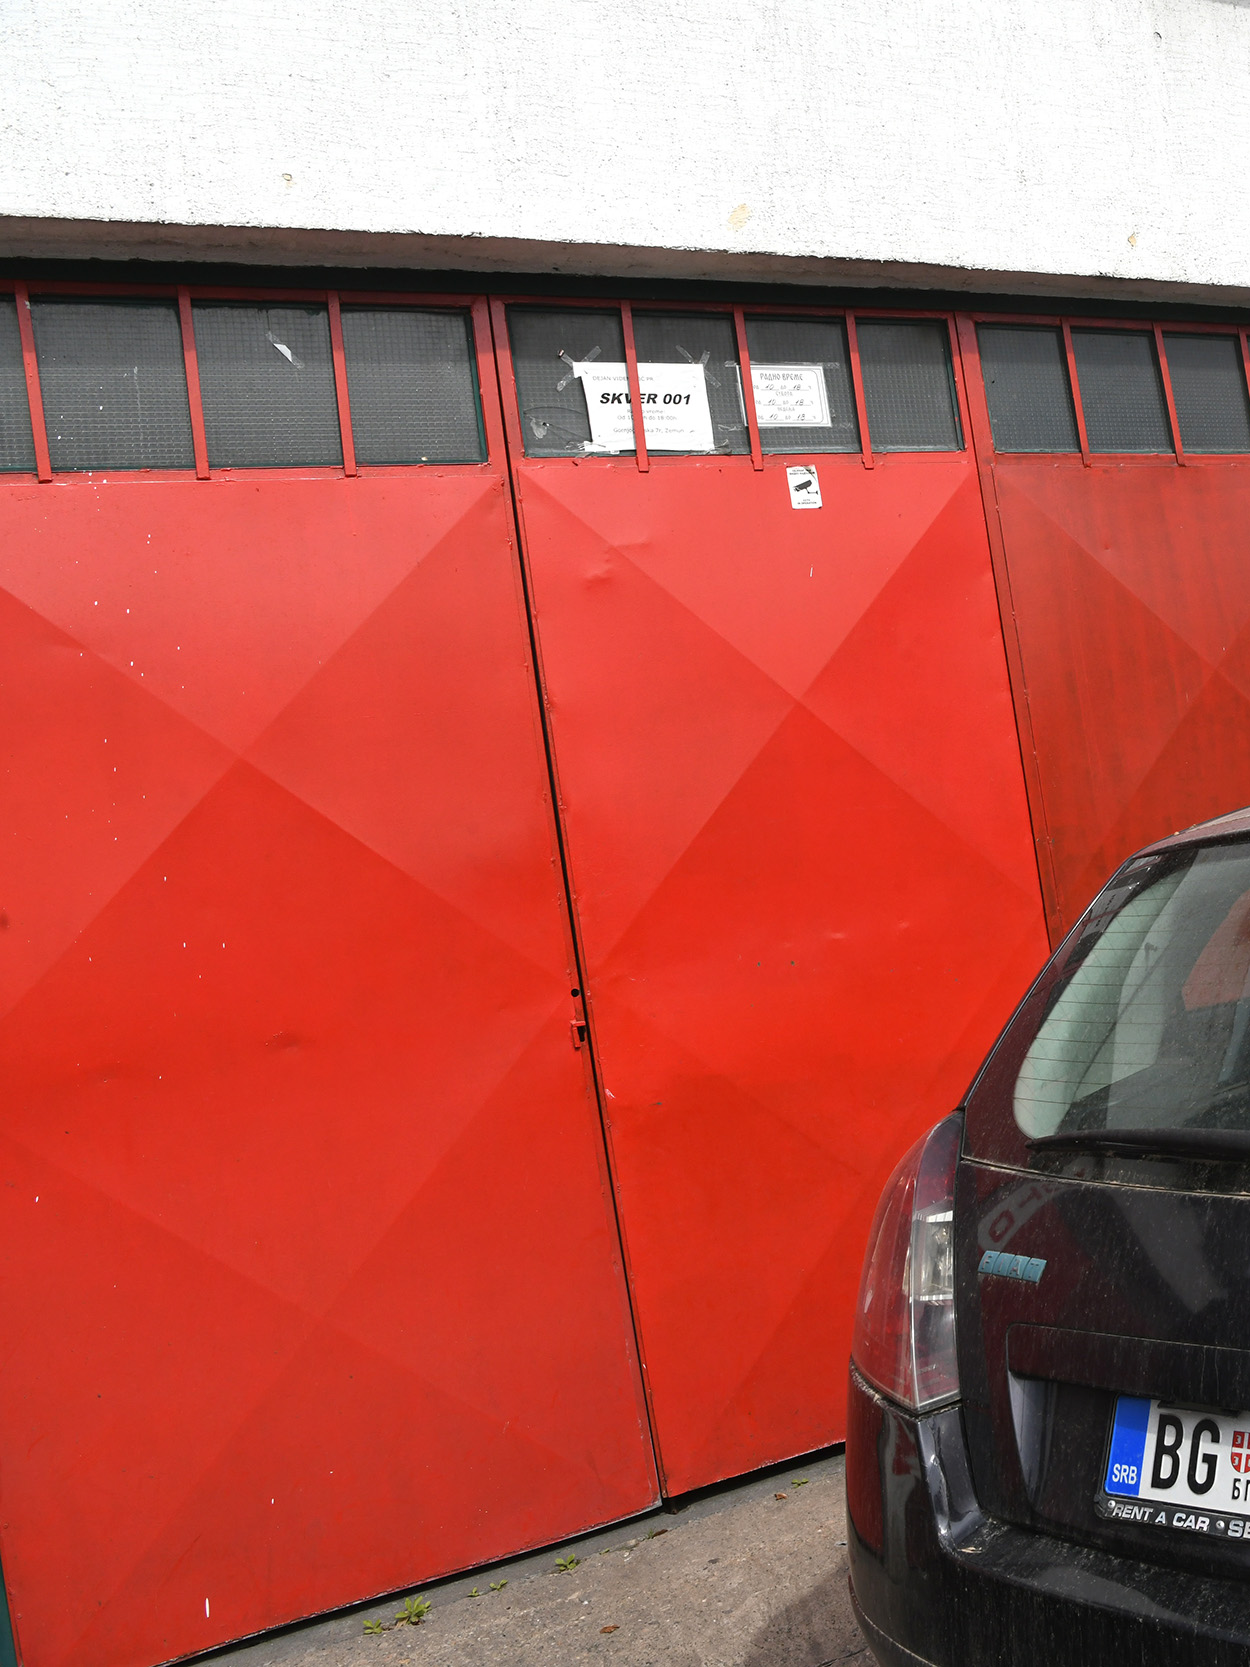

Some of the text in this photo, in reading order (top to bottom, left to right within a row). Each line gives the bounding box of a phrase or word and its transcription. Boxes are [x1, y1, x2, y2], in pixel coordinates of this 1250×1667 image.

[760, 373, 803, 381] РАДНО ВРЕМЕ
[663, 393, 691, 405] 001
[979, 1252, 1044, 1280] FIAT
[1151, 1413, 1221, 1495] BG
[1111, 1463, 1138, 1485] SRB
[1112, 1503, 1154, 1522] RENT
[1155, 1511, 1167, 1524] A
[1172, 1512, 1210, 1532] CAR
